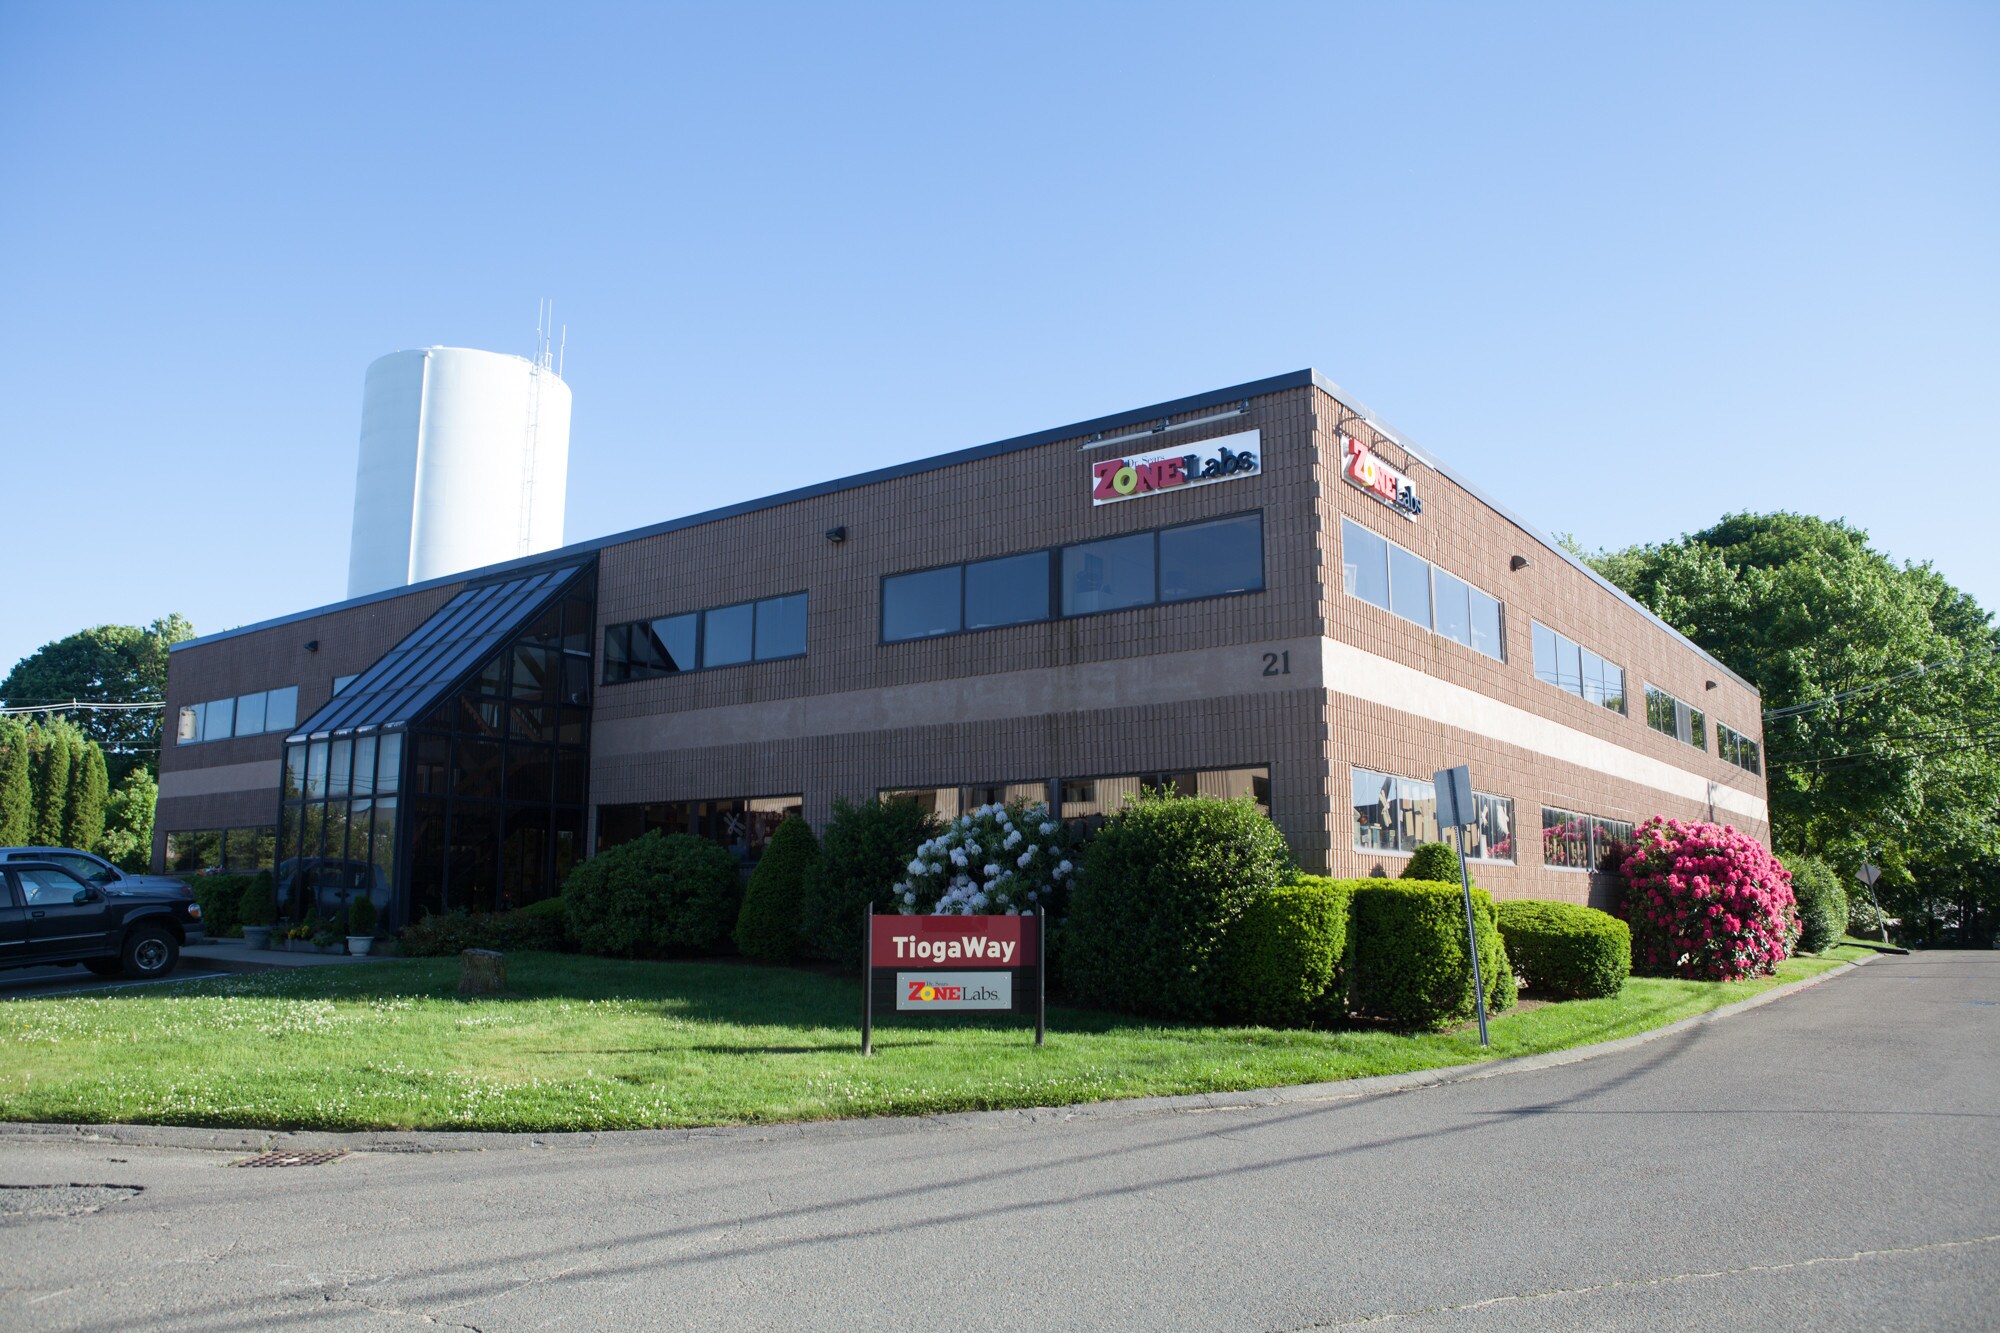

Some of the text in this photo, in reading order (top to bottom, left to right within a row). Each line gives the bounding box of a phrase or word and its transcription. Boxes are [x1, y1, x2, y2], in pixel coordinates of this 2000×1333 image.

[1262, 650, 1291, 677] 21
[908, 981, 998, 1001] ZONE Labs
